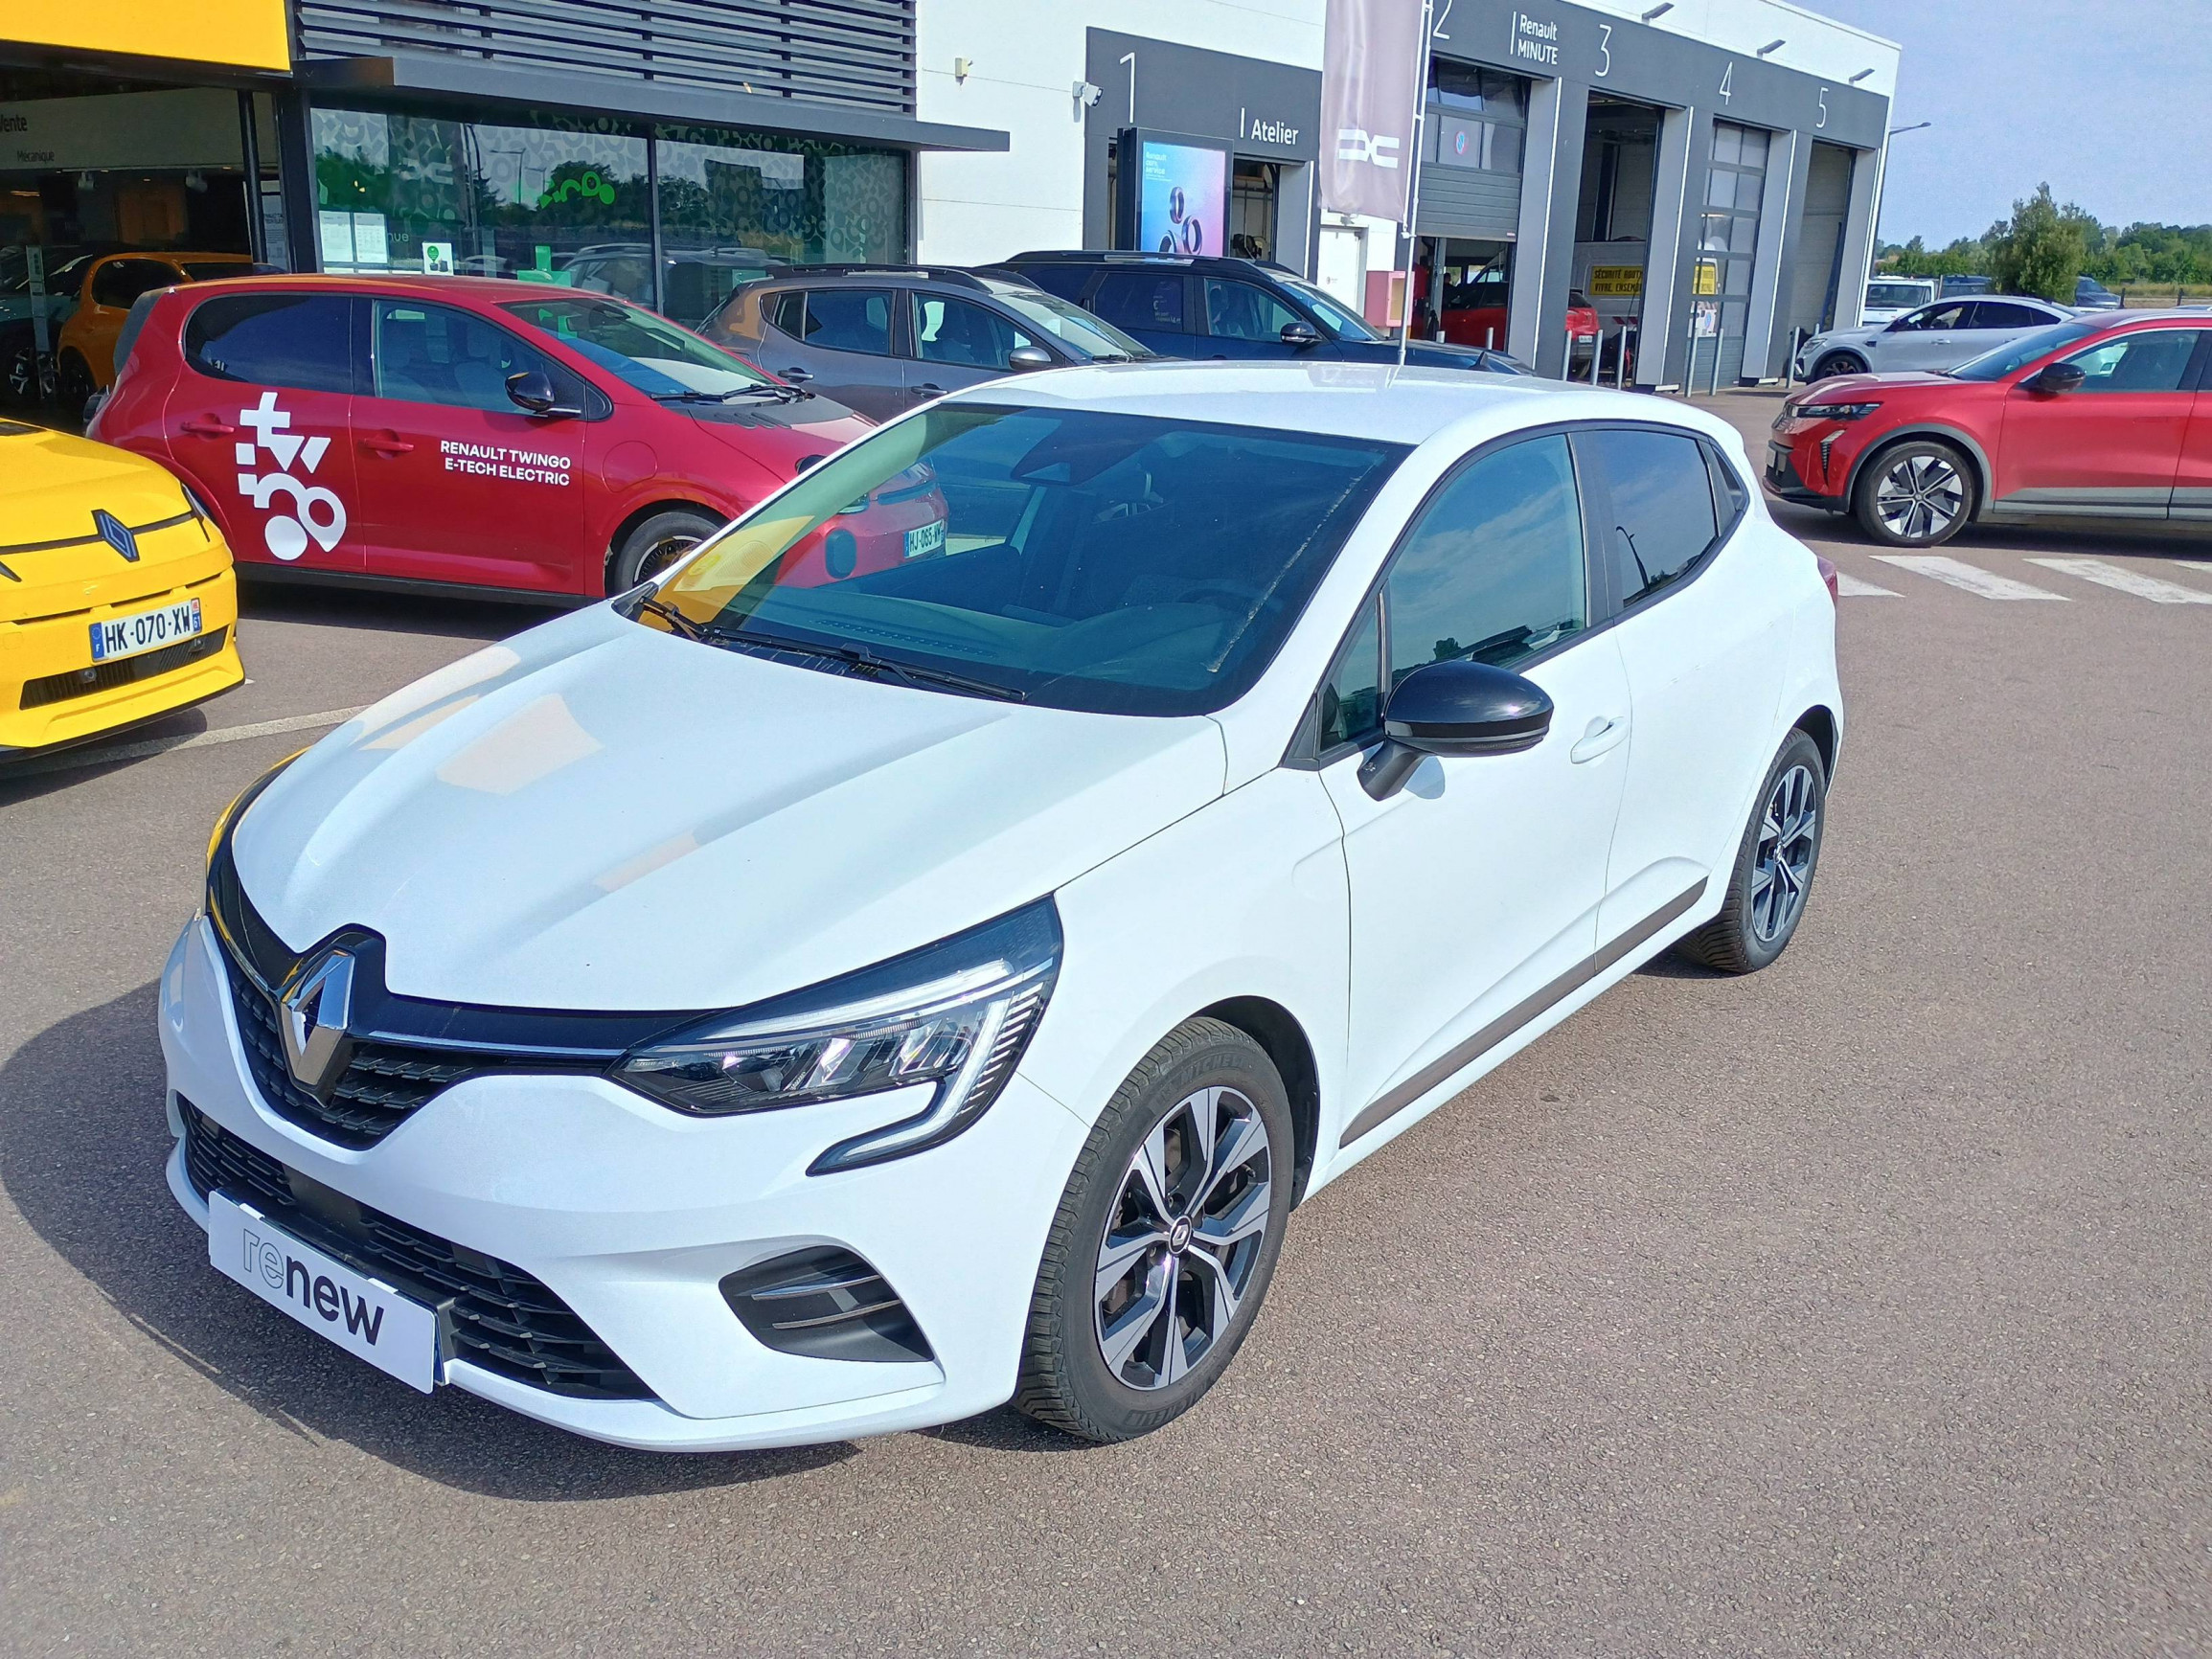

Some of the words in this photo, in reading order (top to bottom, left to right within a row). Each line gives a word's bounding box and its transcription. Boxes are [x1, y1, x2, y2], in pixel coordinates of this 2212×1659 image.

[1518, 13, 1559, 41] Renault
[1516, 38, 1559, 65] MINUTE
[1594, 24, 1612, 78] 3
[1119, 52, 1136, 124] 1
[1719, 61, 1733, 105] 4
[1815, 86, 1829, 128] 5
[1250, 119, 1299, 146] Atelier
[441, 440, 507, 461] RENAULT
[509, 449, 571, 469] TWINGO
[445, 457, 497, 477] E-TECH
[499, 465, 570, 487] ELECTRIC
[104, 605, 191, 653] HK-070-XW
[242, 1228, 385, 1347] renew
